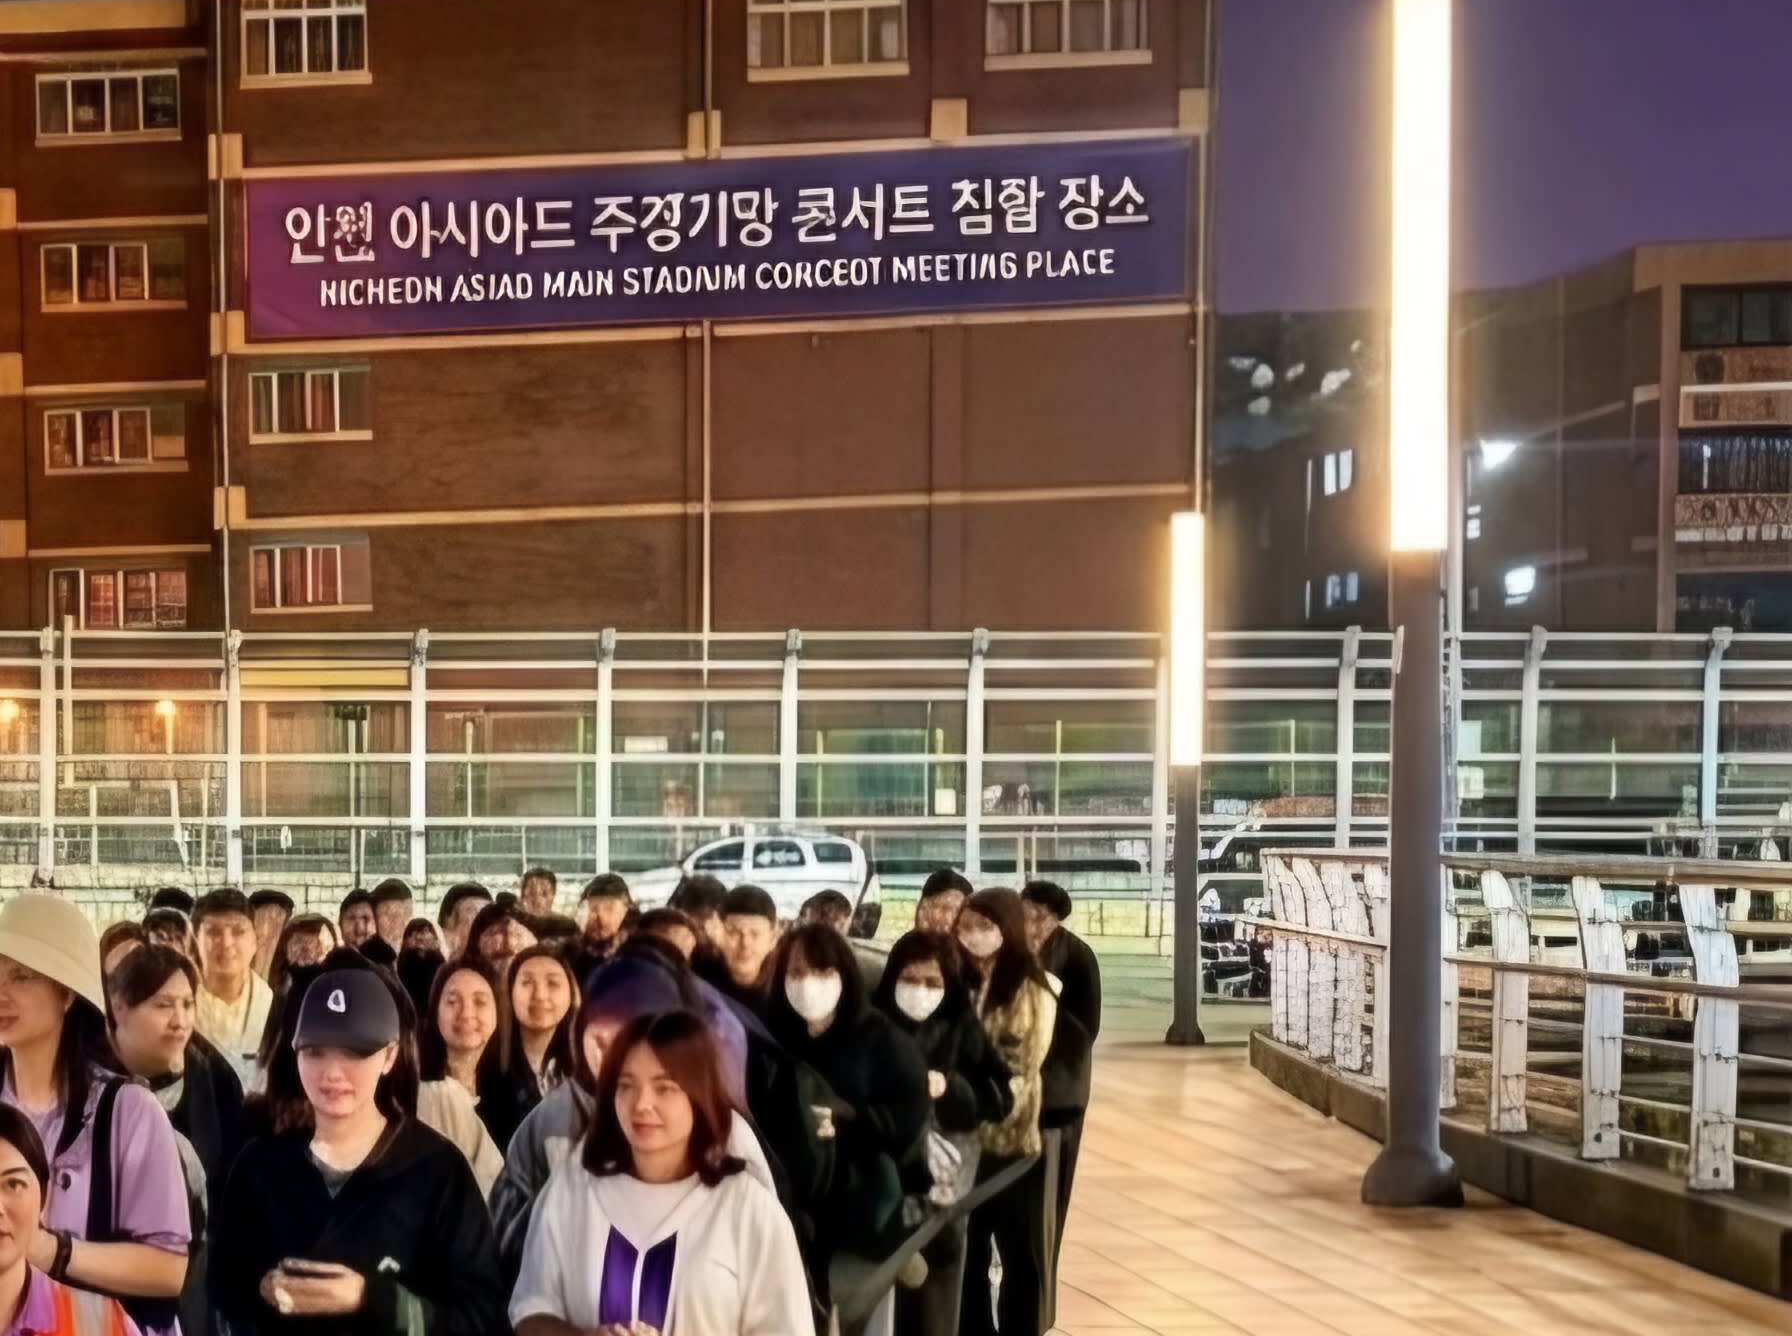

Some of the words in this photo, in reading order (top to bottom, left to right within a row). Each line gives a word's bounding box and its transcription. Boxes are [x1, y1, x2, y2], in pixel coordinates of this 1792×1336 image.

[390, 197, 576, 258] 아시아드
[1059, 174, 1150, 231] 장소
[1026, 248, 1116, 278] PLACE
